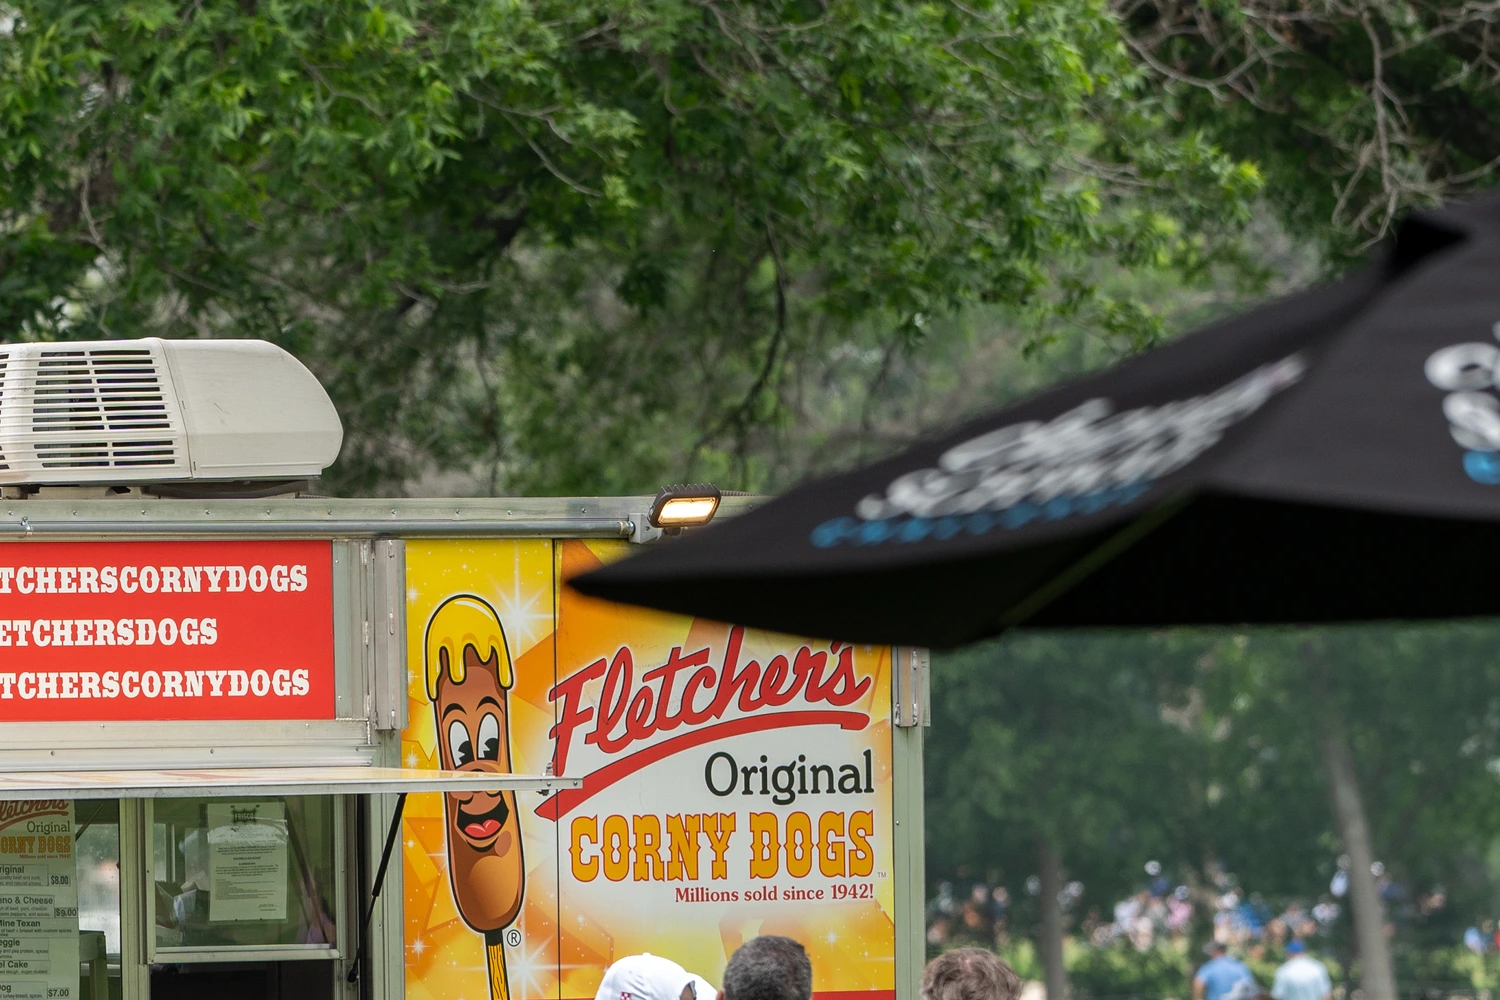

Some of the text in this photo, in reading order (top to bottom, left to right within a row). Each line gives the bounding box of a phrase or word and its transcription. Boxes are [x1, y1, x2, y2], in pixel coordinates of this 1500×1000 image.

[704, 749, 874, 806] Original
[234, 812, 254, 820] FRISCO
[27, 820, 71, 835] Original
[37, 835, 71, 854] DOGS
[569, 812, 736, 883] CORNY
[749, 809, 875, 880] DOGS
[50, 876, 68, 885] $8.00
[674, 884, 874, 903] Millions sold since 1942!
[14, 896, 20, 904] &
[23, 896, 53, 904] Cheese
[56, 908, 77, 917] $9.00
[48, 989, 69, 998] $7.00
